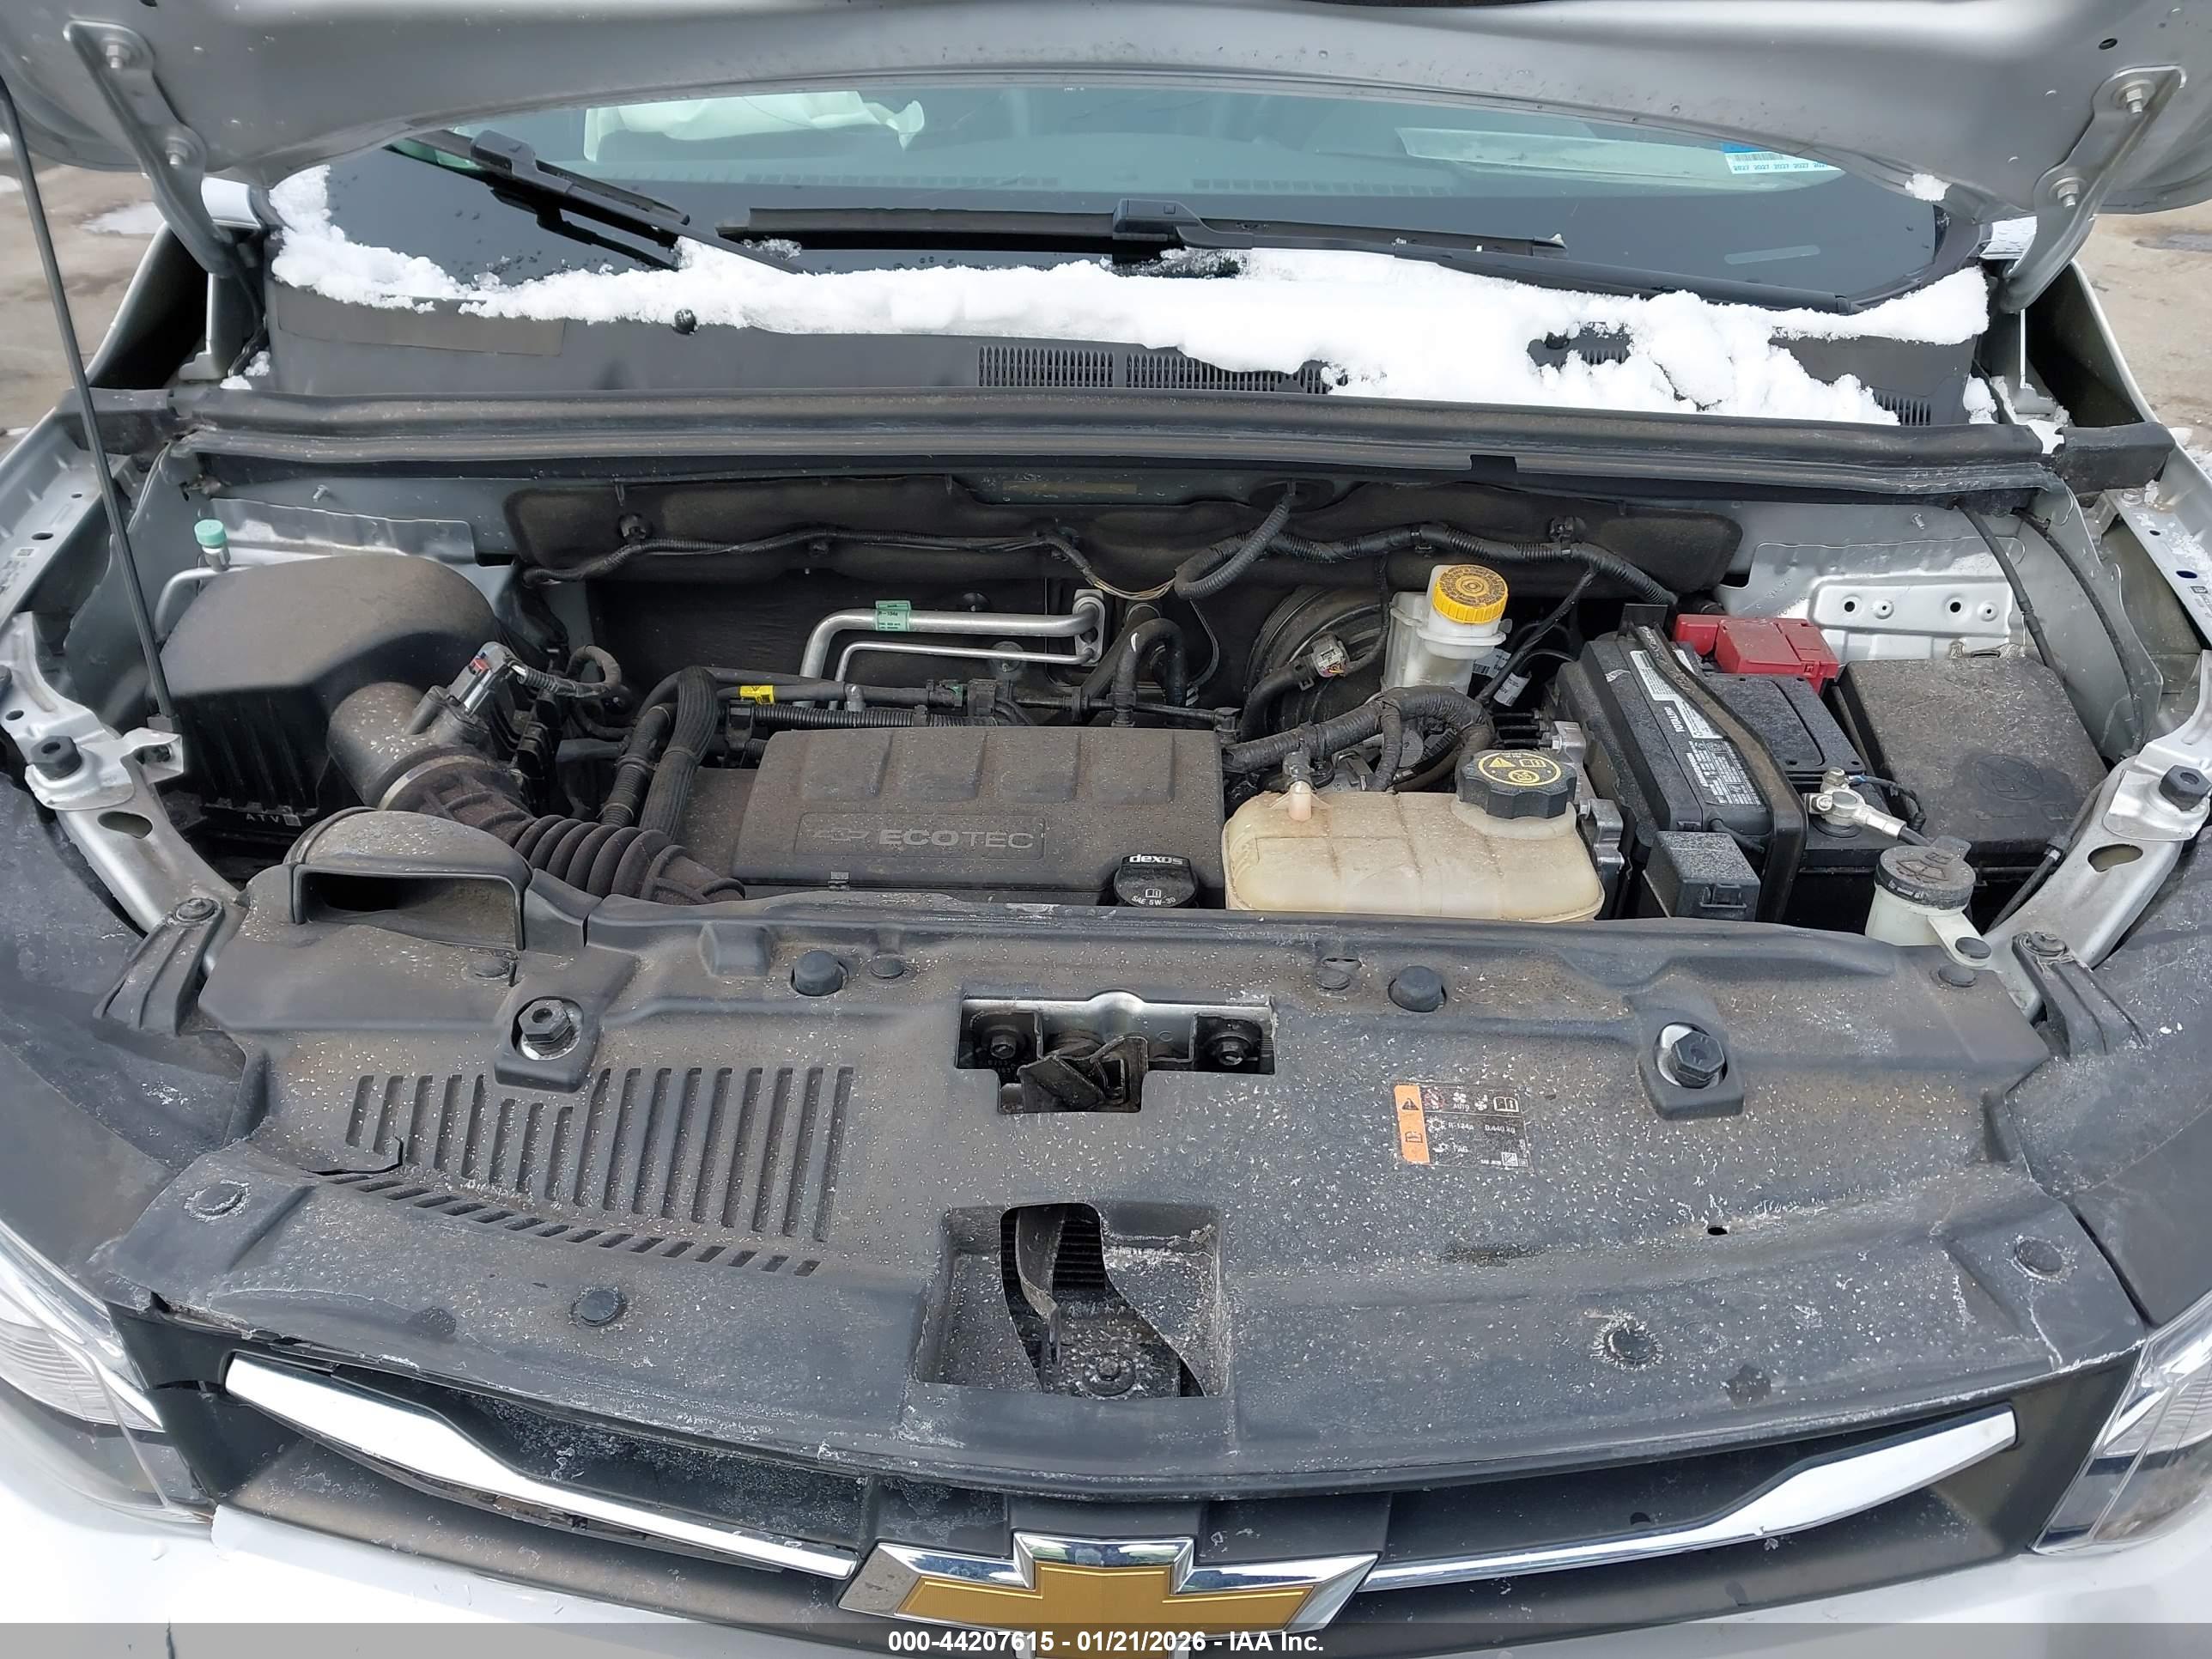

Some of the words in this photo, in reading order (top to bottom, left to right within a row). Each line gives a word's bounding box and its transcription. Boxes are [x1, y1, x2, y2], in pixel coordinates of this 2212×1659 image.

[878, 830, 1034, 849] ECOTEC
[1129, 854, 1183, 865] dexos
[1131, 895, 1147, 905] SAE
[1149, 896, 1176, 906] 5W-30
